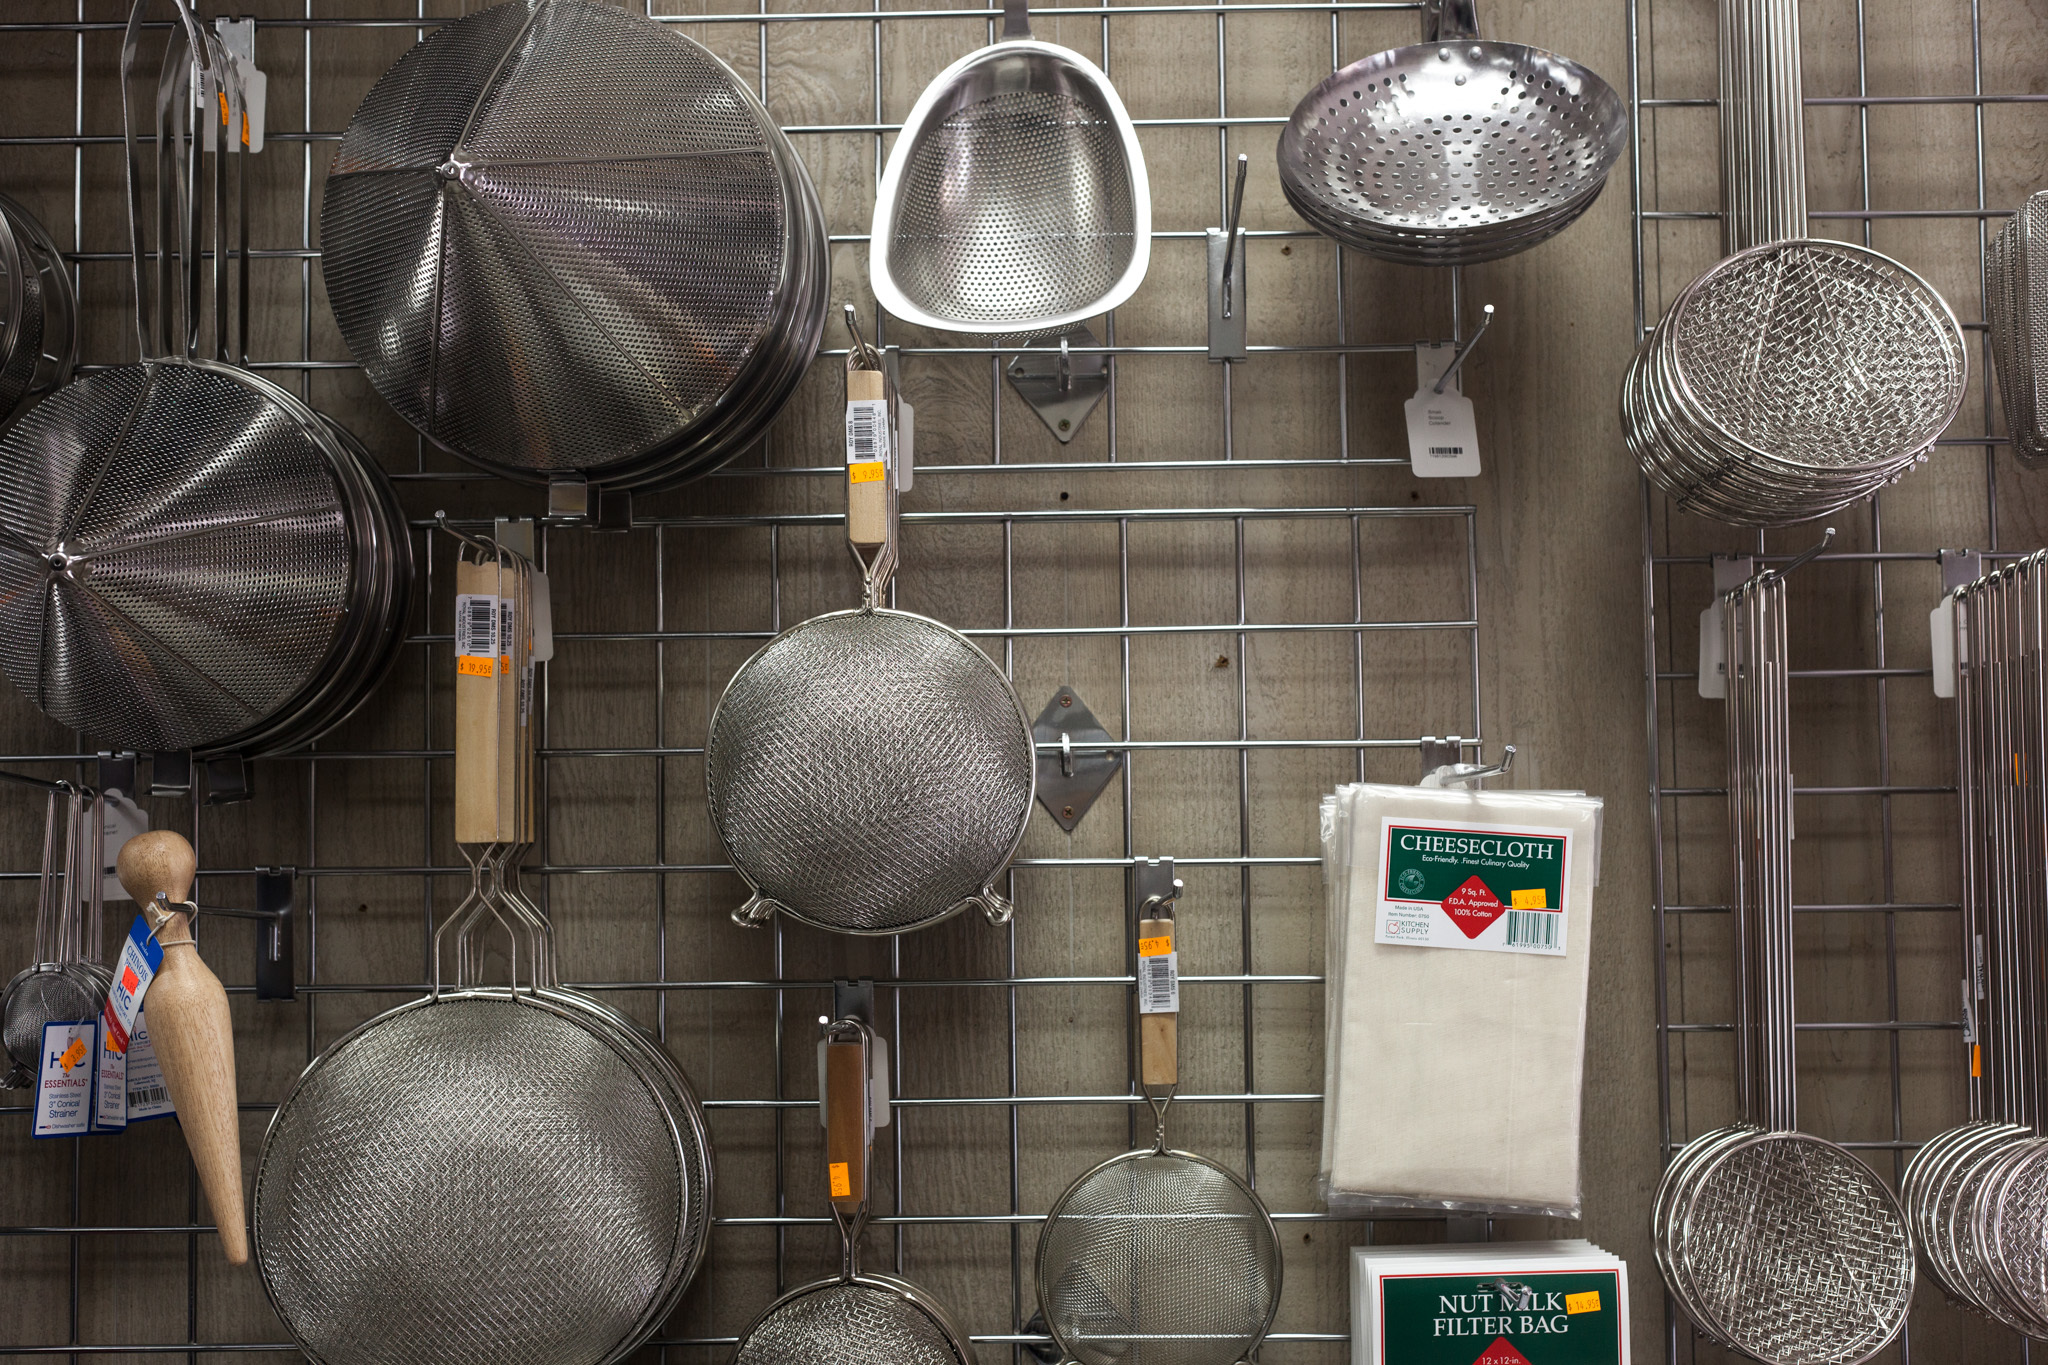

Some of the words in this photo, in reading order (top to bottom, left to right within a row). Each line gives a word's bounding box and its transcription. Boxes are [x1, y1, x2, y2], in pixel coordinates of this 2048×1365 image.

[1400, 834, 1554, 860] CHEESECLOTH
[1481, 858, 1506, 868] Culinary
[1507, 860, 1530, 870] Quality
[1467, 888, 1477, 897] Sq.
[1468, 899, 1499, 908] Approved
[1454, 908, 1471, 916] 100%
[1401, 920, 1429, 928] KITCHEN
[1401, 927, 1429, 935] SUPPLY
[127, 945, 149, 982] CHINOIS
[116, 980, 131, 1011] HIC
[44, 1079, 86, 1088] ESSENTIALS
[57, 1099, 80, 1108] Conical
[49, 1109, 78, 1118] Strainer
[1438, 1294, 1494, 1314] NUT
[1499, 1291, 1563, 1312] MLK
[1433, 1316, 1514, 1337] FILTER
[1519, 1314, 1569, 1334] BAG
[1482, 1357, 1492, 1365] 12
[1500, 1356, 1521, 1365] 12-in.
